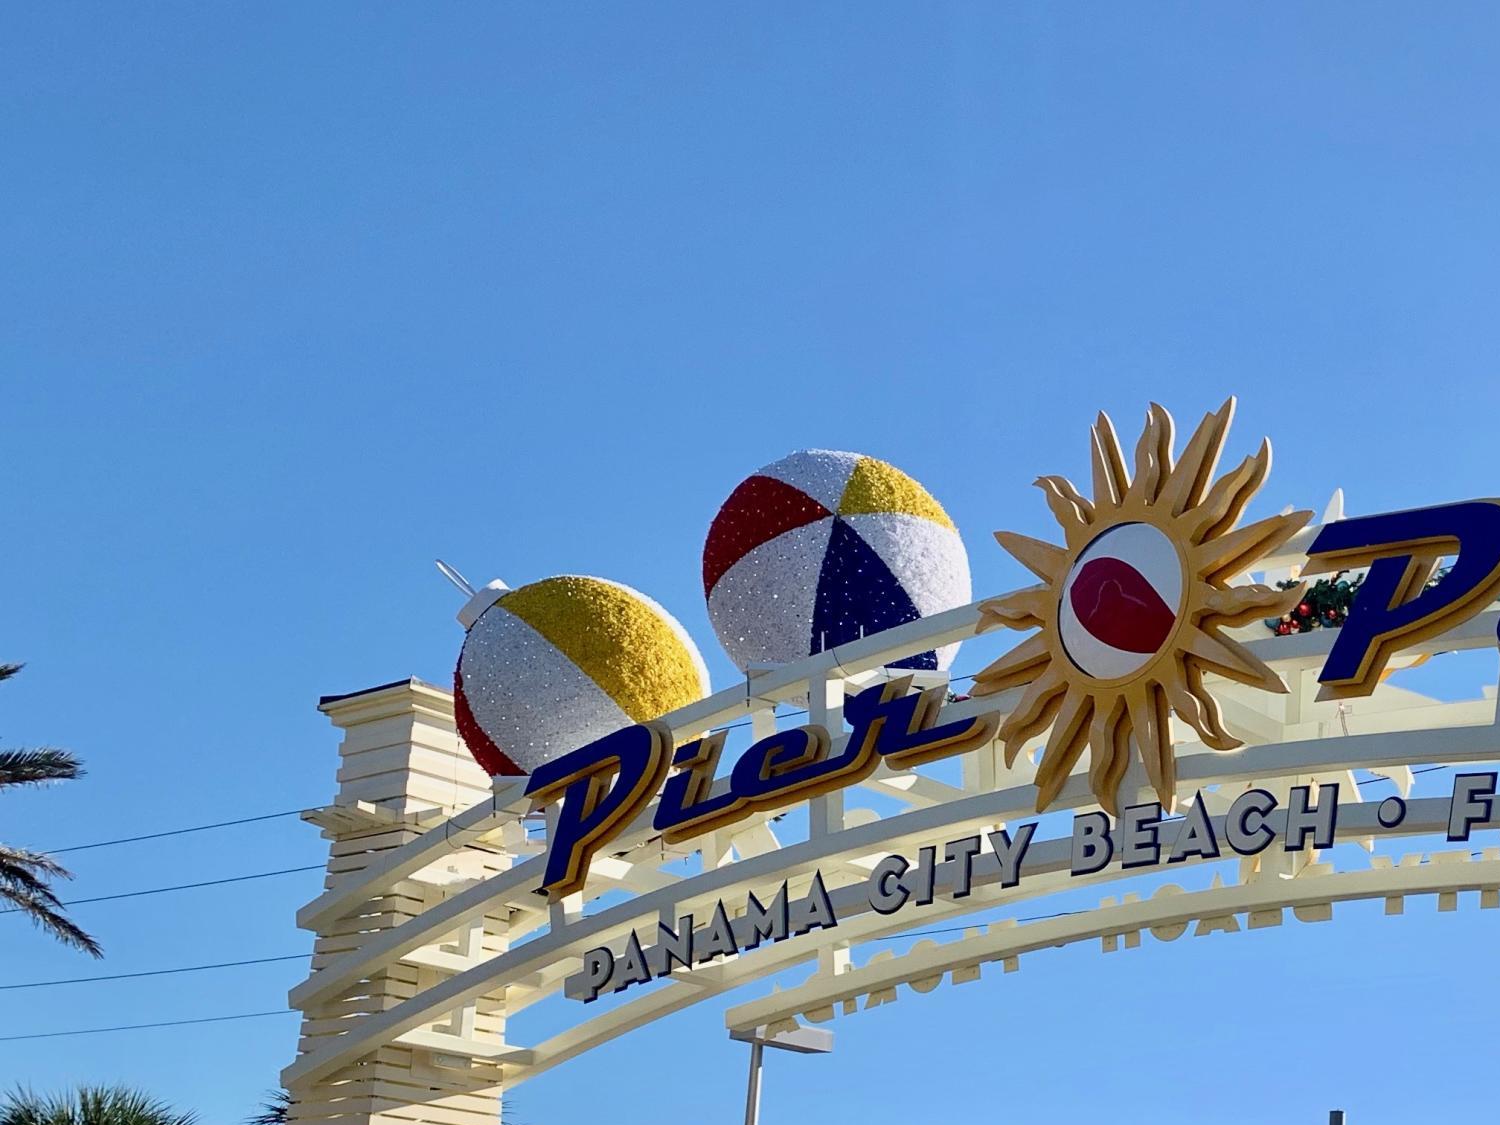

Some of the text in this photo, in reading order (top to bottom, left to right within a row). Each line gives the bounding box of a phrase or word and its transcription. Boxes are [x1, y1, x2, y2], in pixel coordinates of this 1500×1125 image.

[524, 675, 999, 902] Pier
[583, 869, 838, 1004] PANAMA
[869, 822, 1038, 915] CITY
[1071, 783, 1340, 877] BEACH
